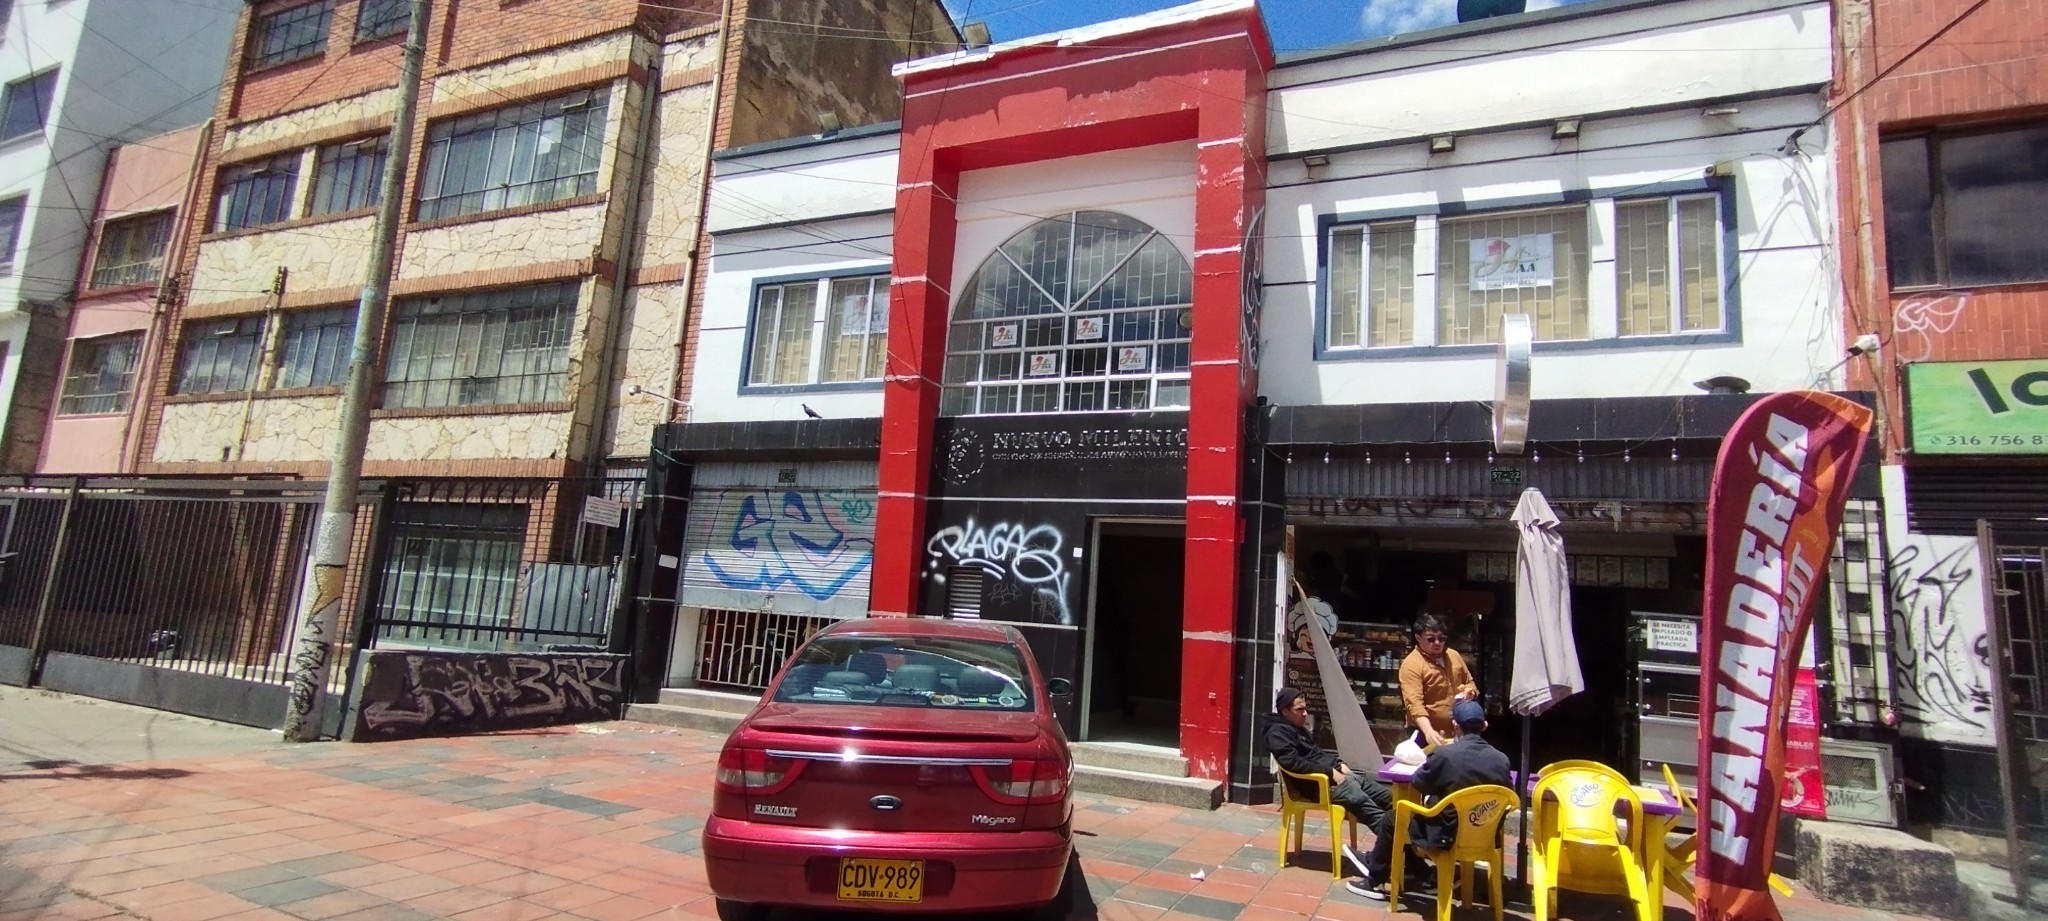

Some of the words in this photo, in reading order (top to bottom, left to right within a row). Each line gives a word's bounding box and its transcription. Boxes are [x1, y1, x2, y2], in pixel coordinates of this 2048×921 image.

[1946, 435, 1981, 446] 316
[1989, 435, 2024, 446] 756
[2031, 435, 2048, 445] 8
[1651, 628, 1685, 636] EMPLEADO
[1655, 634, 1689, 642] EMPLEADA
[1710, 412, 1809, 866] PANADERÍA
[754, 803, 798, 818] RENAULT
[857, 889, 884, 898] BOGOTA
